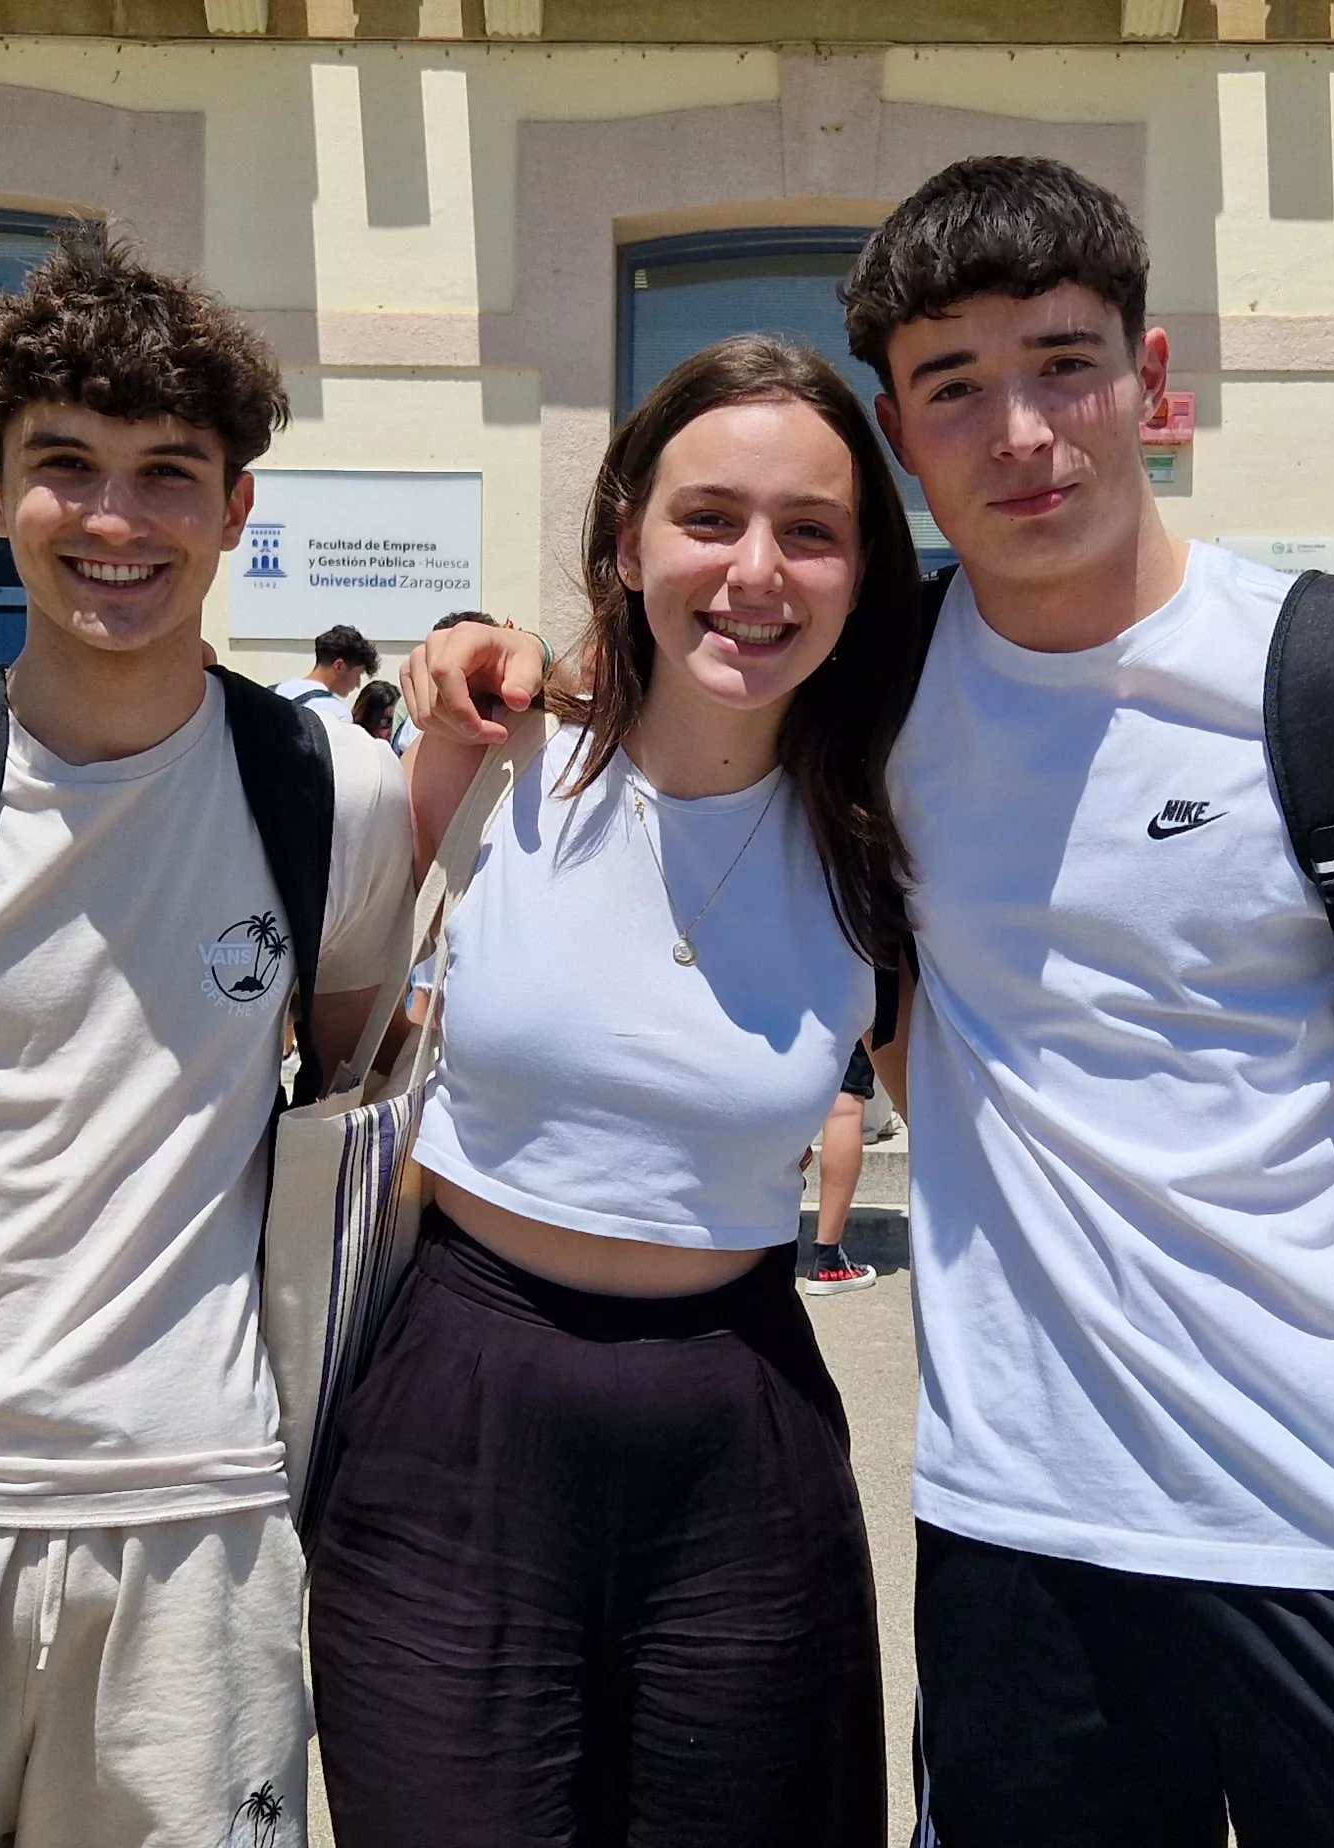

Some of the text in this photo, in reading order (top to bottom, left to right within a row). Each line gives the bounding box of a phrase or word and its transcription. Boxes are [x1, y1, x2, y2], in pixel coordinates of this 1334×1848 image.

[308, 539, 437, 553] Facultad de Empresa
[308, 558, 316, 569] y
[318, 556, 367, 567] Gestión
[369, 556, 416, 568] Pública
[425, 557, 470, 569] Huesca
[309, 574, 471, 592] Universidad Zaragoza
[1160, 799, 1210, 823] NIKE
[198, 942, 253, 965] VANS
[227, 1002, 255, 1017] THE
